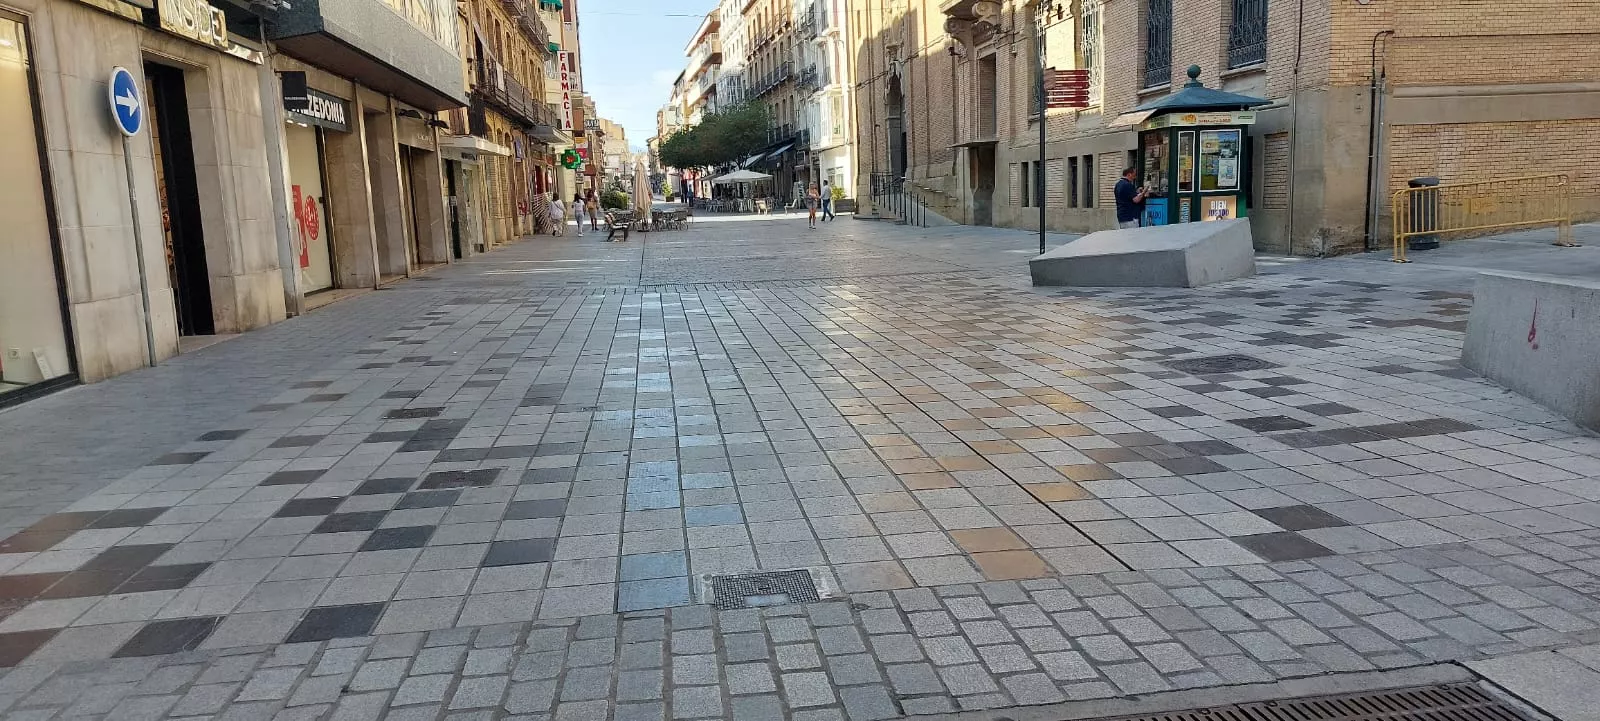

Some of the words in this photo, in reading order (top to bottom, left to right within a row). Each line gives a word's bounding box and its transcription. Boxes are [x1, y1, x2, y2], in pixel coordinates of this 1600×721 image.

[560, 54, 571, 128] FARMACIA
[291, 94, 345, 124] ZEDONIA
[1211, 200, 1227, 209] BIEN
